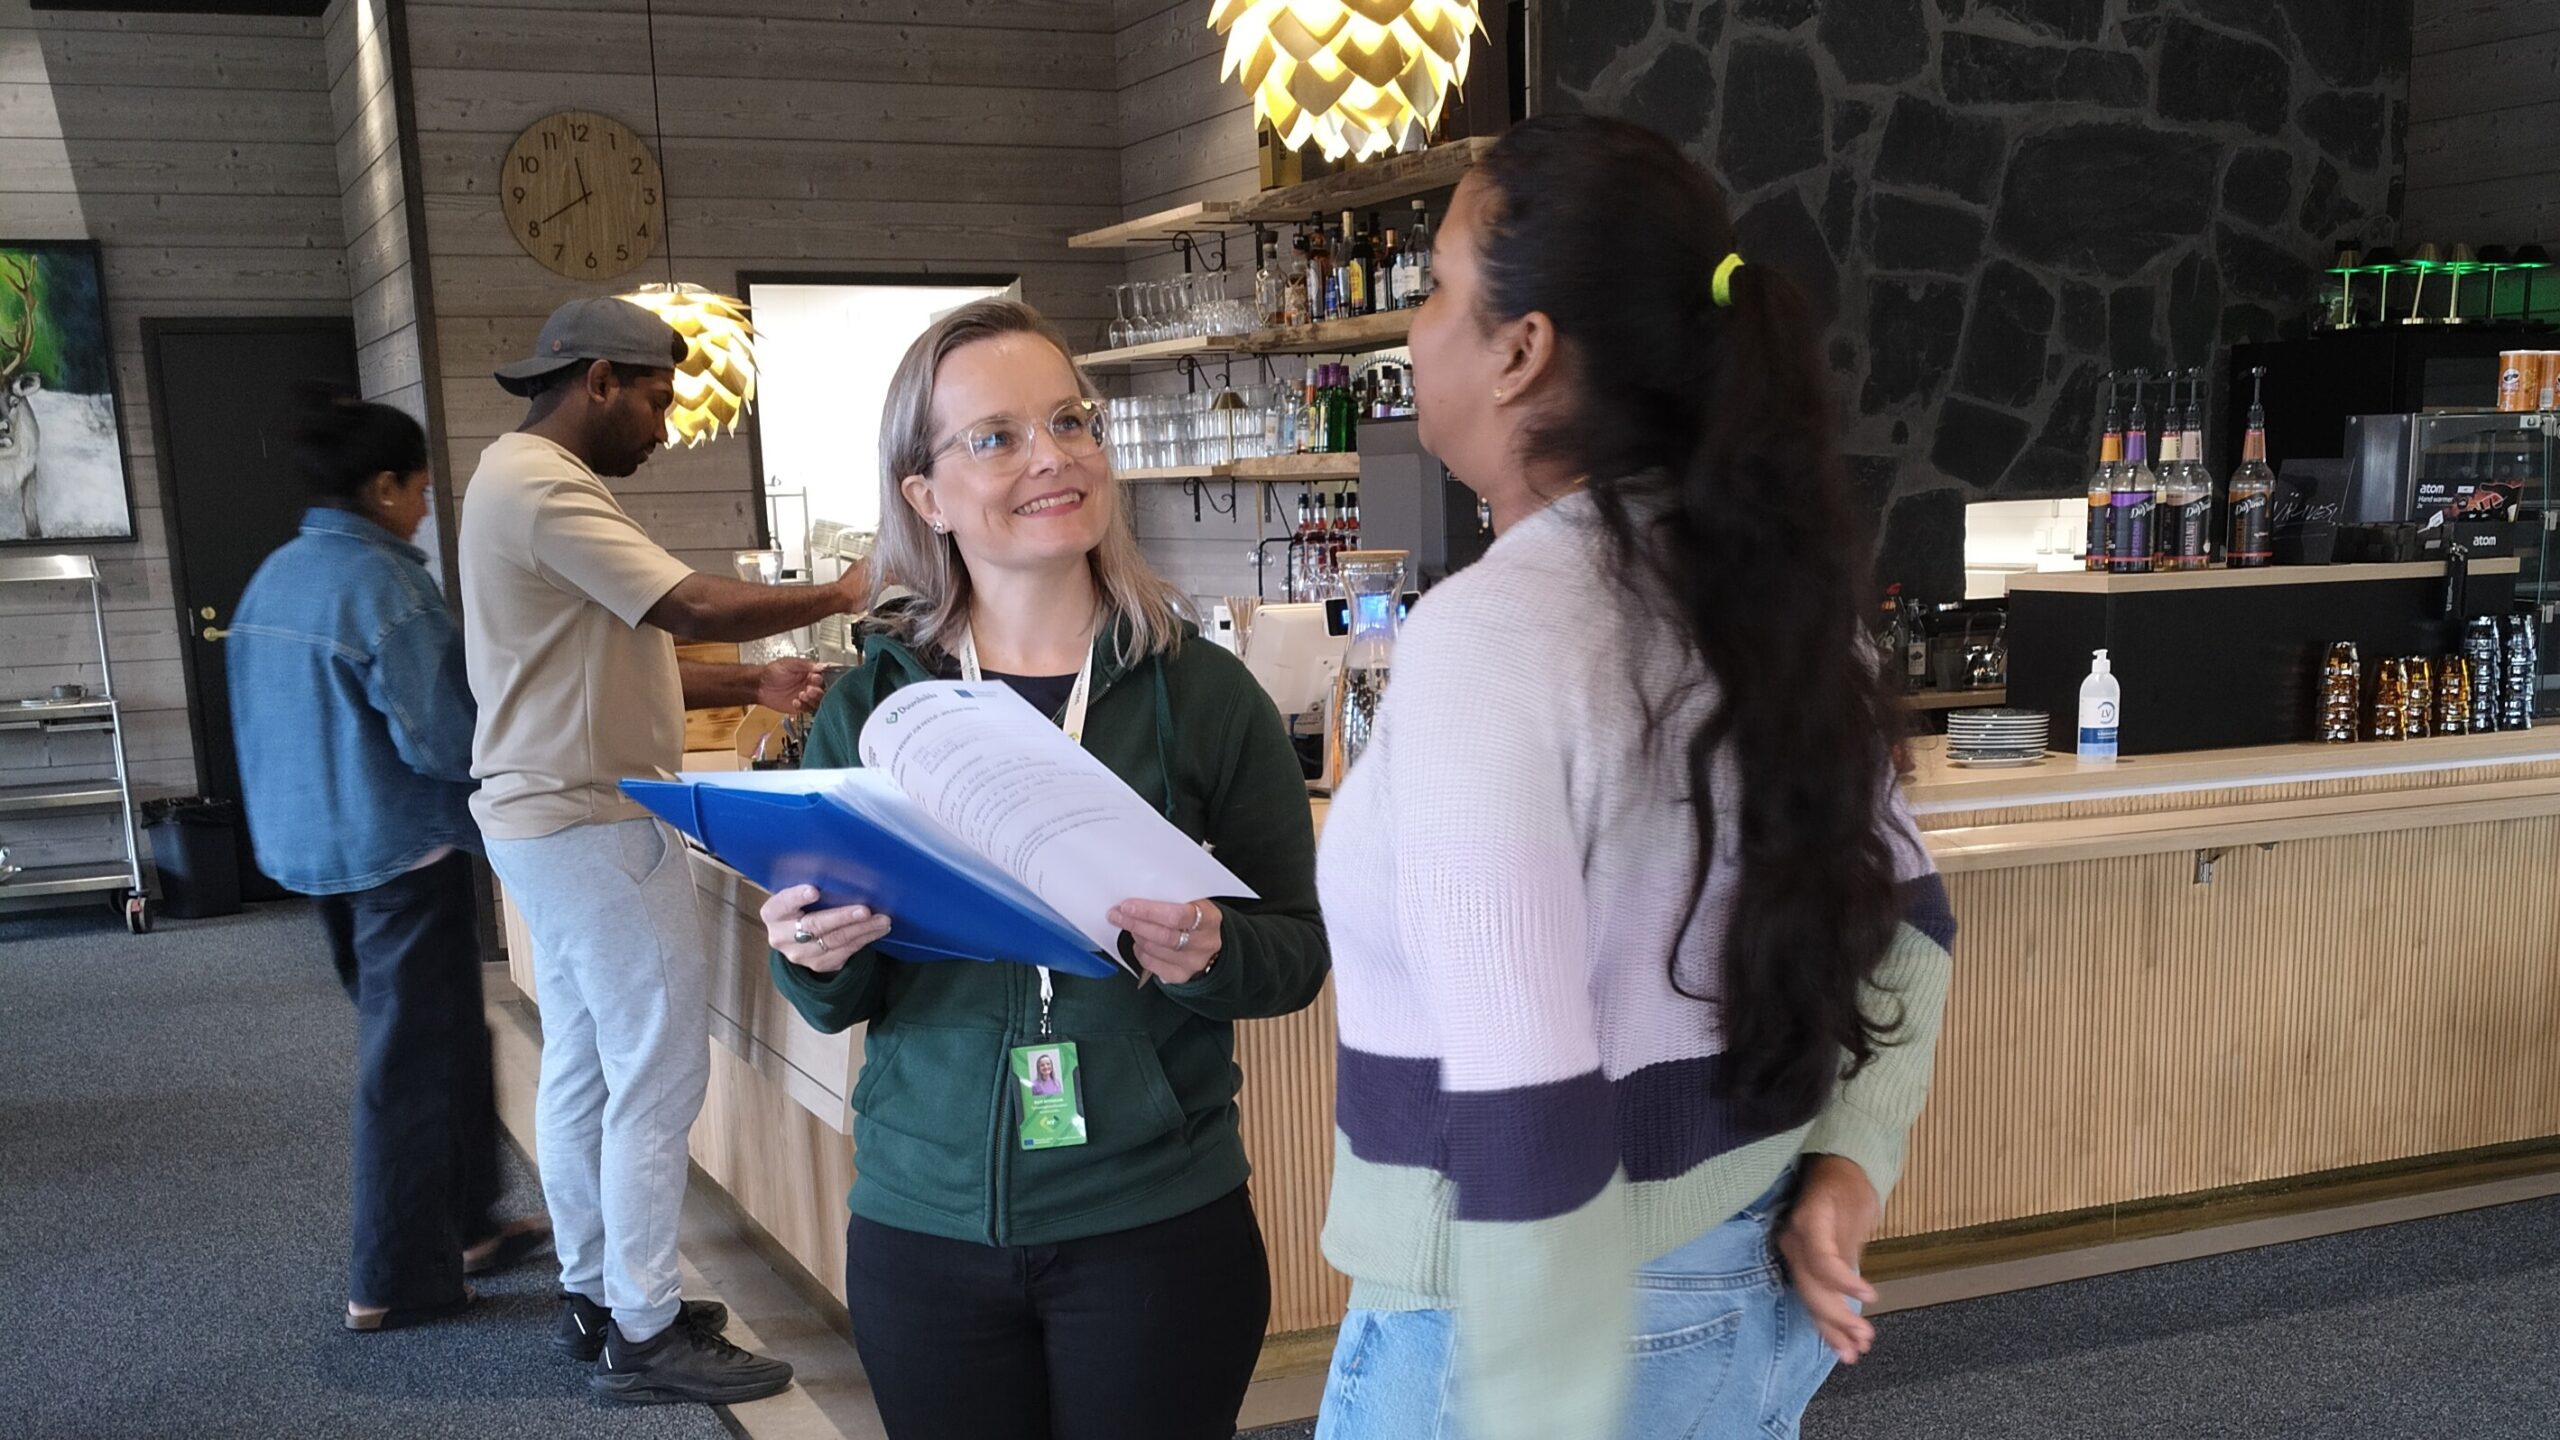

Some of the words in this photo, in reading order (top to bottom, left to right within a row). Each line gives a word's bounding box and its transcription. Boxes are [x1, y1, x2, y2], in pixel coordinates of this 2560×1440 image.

[542, 132, 557, 150] 11
[570, 123, 589, 142] 12
[609, 132, 616, 150] 1
[518, 156, 539, 174] 10
[630, 157, 643, 175] 2
[513, 187, 526, 204] 9
[643, 188, 656, 205] 3
[528, 220, 541, 238] 8
[636, 223, 649, 239] 4
[553, 244, 566, 261] 7
[585, 252, 598, 269] 6
[616, 244, 629, 261] 5
[2420, 484, 2445, 494] atom
[2185, 521, 2196, 556] HAZELNUT
[2473, 536, 2497, 546] atom
[2101, 709, 2112, 718] LV
